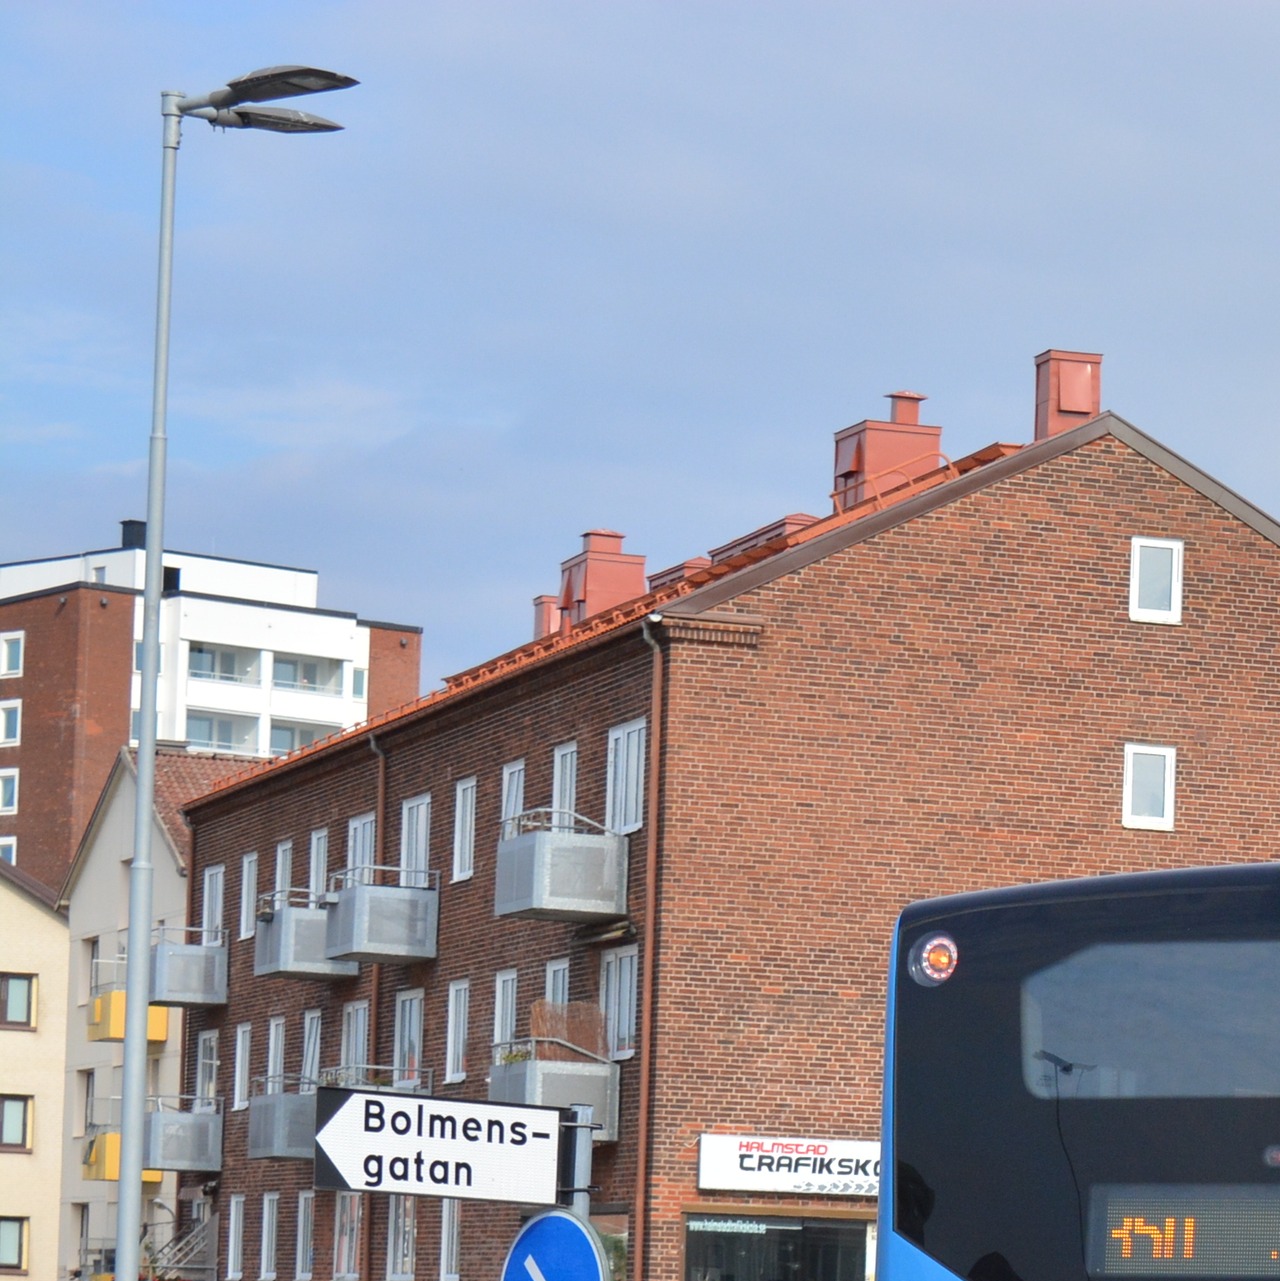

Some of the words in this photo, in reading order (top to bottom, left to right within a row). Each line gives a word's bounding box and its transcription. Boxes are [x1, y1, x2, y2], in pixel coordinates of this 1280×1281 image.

[363, 1099, 551, 1147] Bolmens-
[738, 1141, 829, 1156] HALMSTAD
[363, 1150, 473, 1187] gatan
